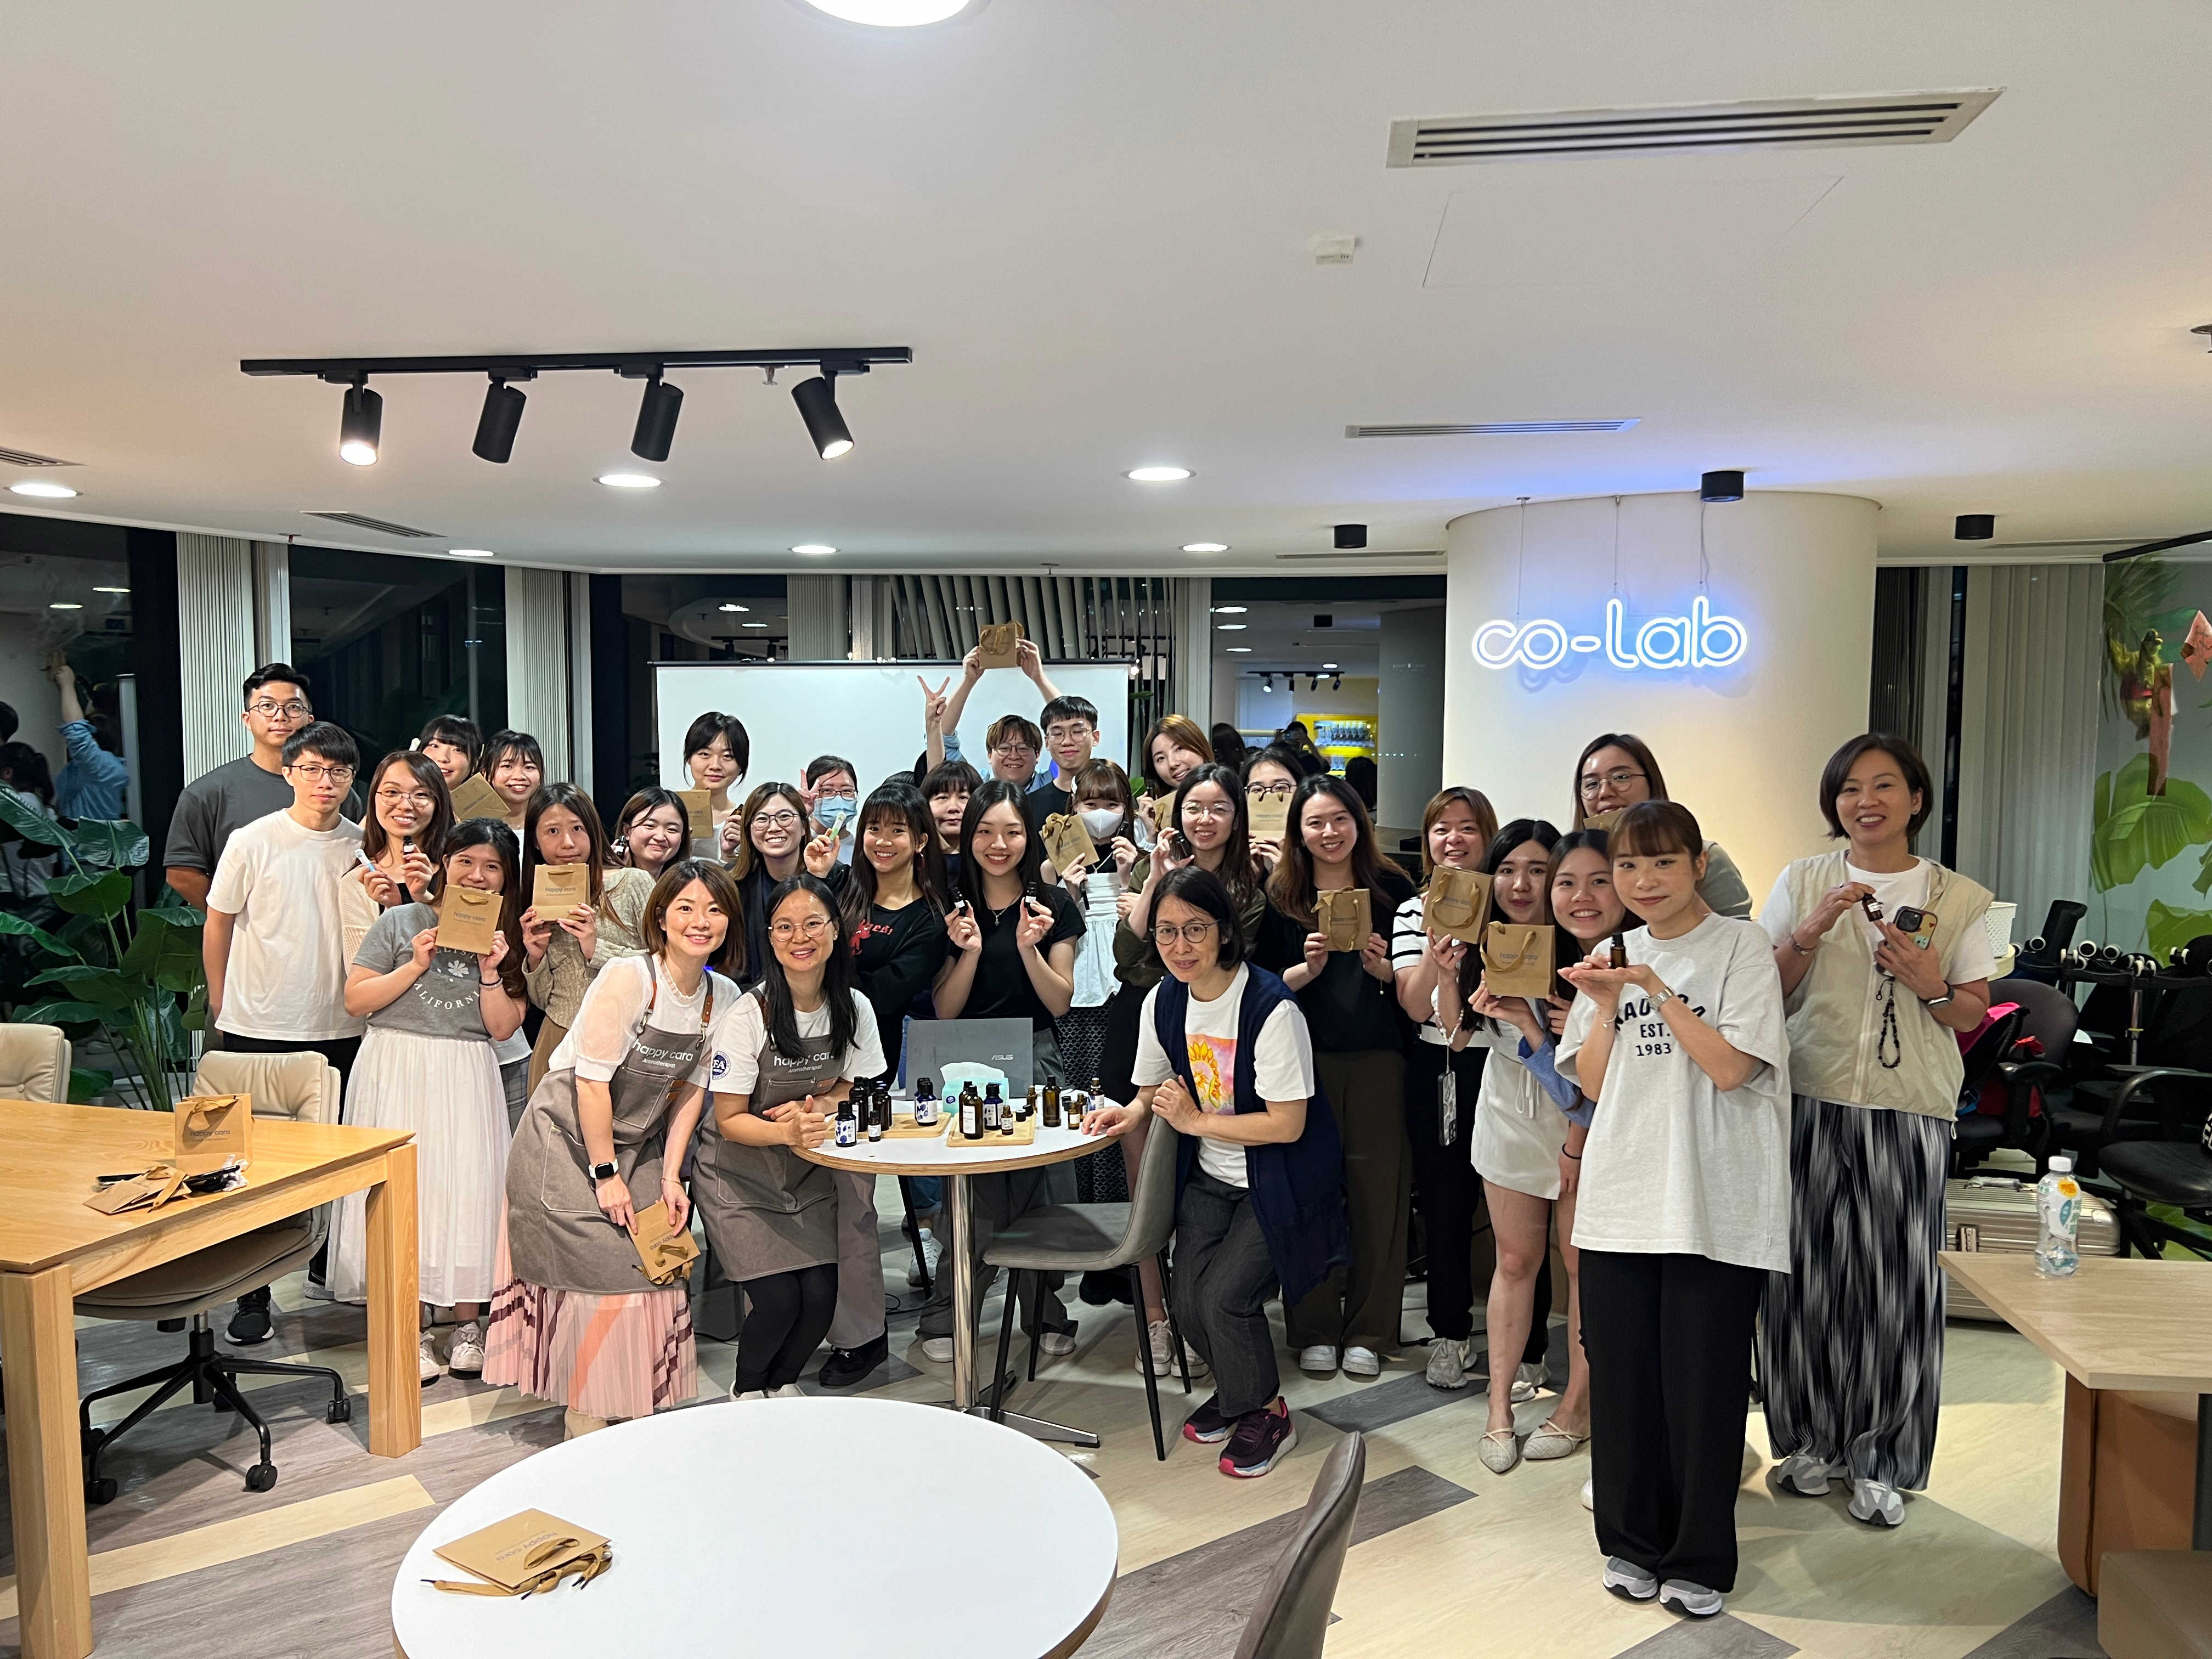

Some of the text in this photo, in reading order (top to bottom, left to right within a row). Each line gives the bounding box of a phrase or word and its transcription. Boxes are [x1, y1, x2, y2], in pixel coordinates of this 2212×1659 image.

[1471, 595, 1748, 670] co-lab
[453, 911, 471, 920] happy
[414, 978, 480, 1009] ALIFORNI
[1640, 1023, 1671, 1038] EST.
[632, 1038, 694, 1062] happy cara
[813, 1052, 834, 1062] car
[1635, 1043, 1672, 1057] 1983
[642, 1058, 676, 1068] Aromatherapist
